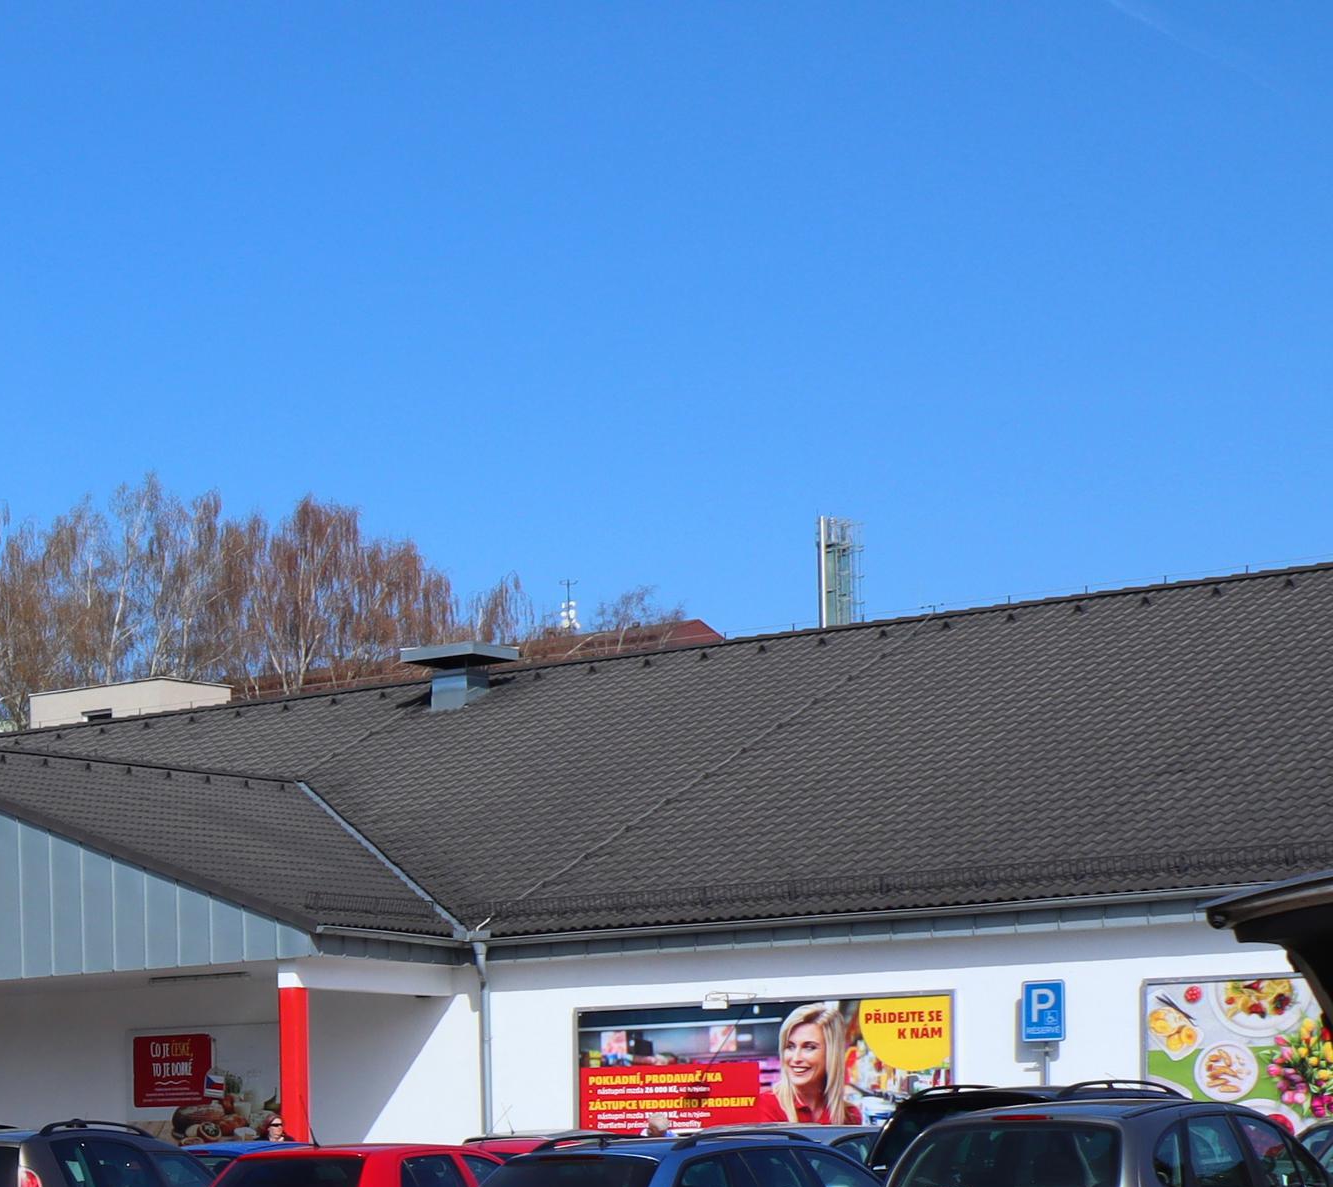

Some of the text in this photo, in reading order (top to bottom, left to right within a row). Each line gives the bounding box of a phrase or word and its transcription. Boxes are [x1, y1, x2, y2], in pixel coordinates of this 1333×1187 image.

[1031, 989, 1055, 1023] P
[864, 1009, 942, 1024] PŘIDEJTE SE
[897, 1024, 942, 1039] K NÁM
[150, 1042, 161, 1058] CO
[162, 1043, 170, 1058] JE
[152, 1058, 193, 1078] TO JE DOBRÉ
[588, 1070, 722, 1086] POKLADNÍ, PRODAVAČ/KA
[588, 1097, 756, 1111] ZÁSTUPCE VEDOUCÍHO PRODEJNY
